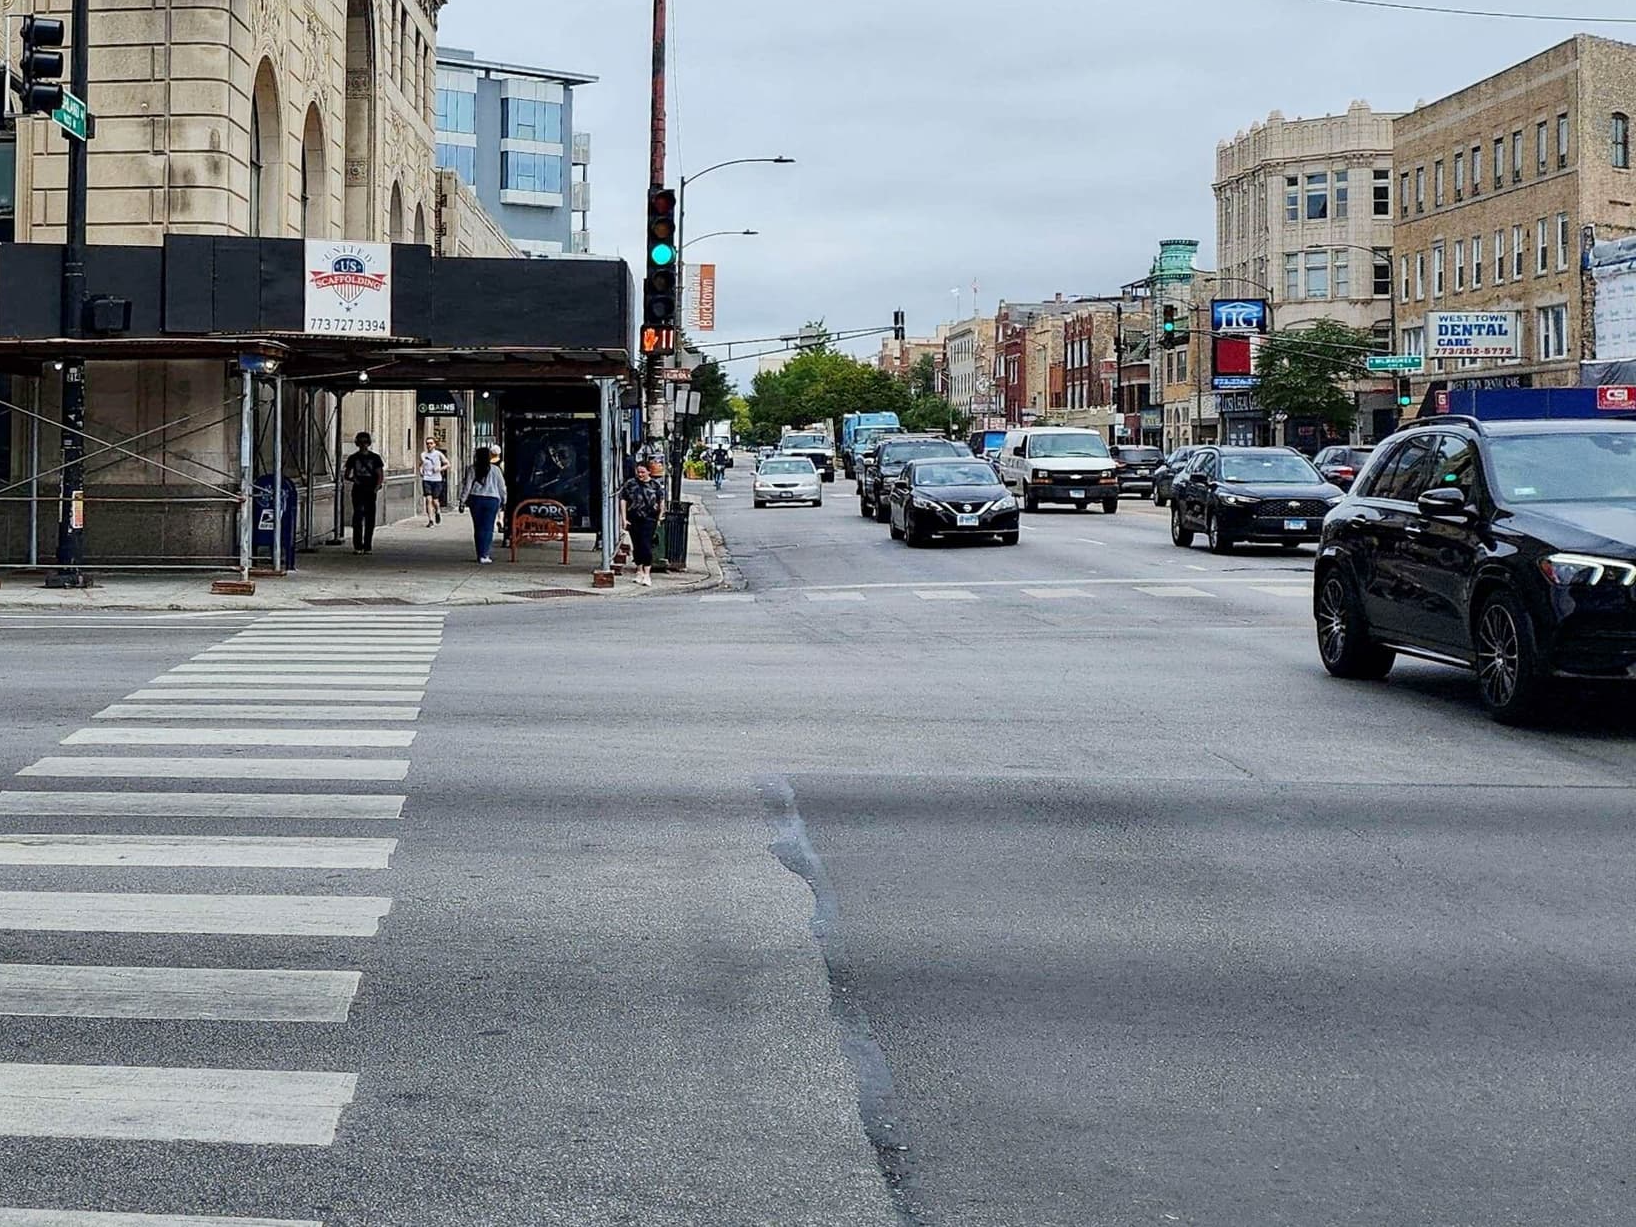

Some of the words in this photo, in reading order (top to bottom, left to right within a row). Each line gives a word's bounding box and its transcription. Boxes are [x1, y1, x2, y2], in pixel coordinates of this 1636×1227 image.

[324, 245, 373, 263] UNITED
[340, 260, 357, 272] US
[316, 275, 381, 290] SCAFFOLDING
[700, 278, 713, 327] Bucktown
[1438, 314, 1470, 322] WEST
[1475, 314, 1508, 322] TOWN
[310, 318, 331, 331] 773
[334, 319, 355, 331] 727
[357, 319, 386, 332] 3394
[1438, 324, 1508, 336] DENTAL
[1437, 338, 1472, 347] CARE
